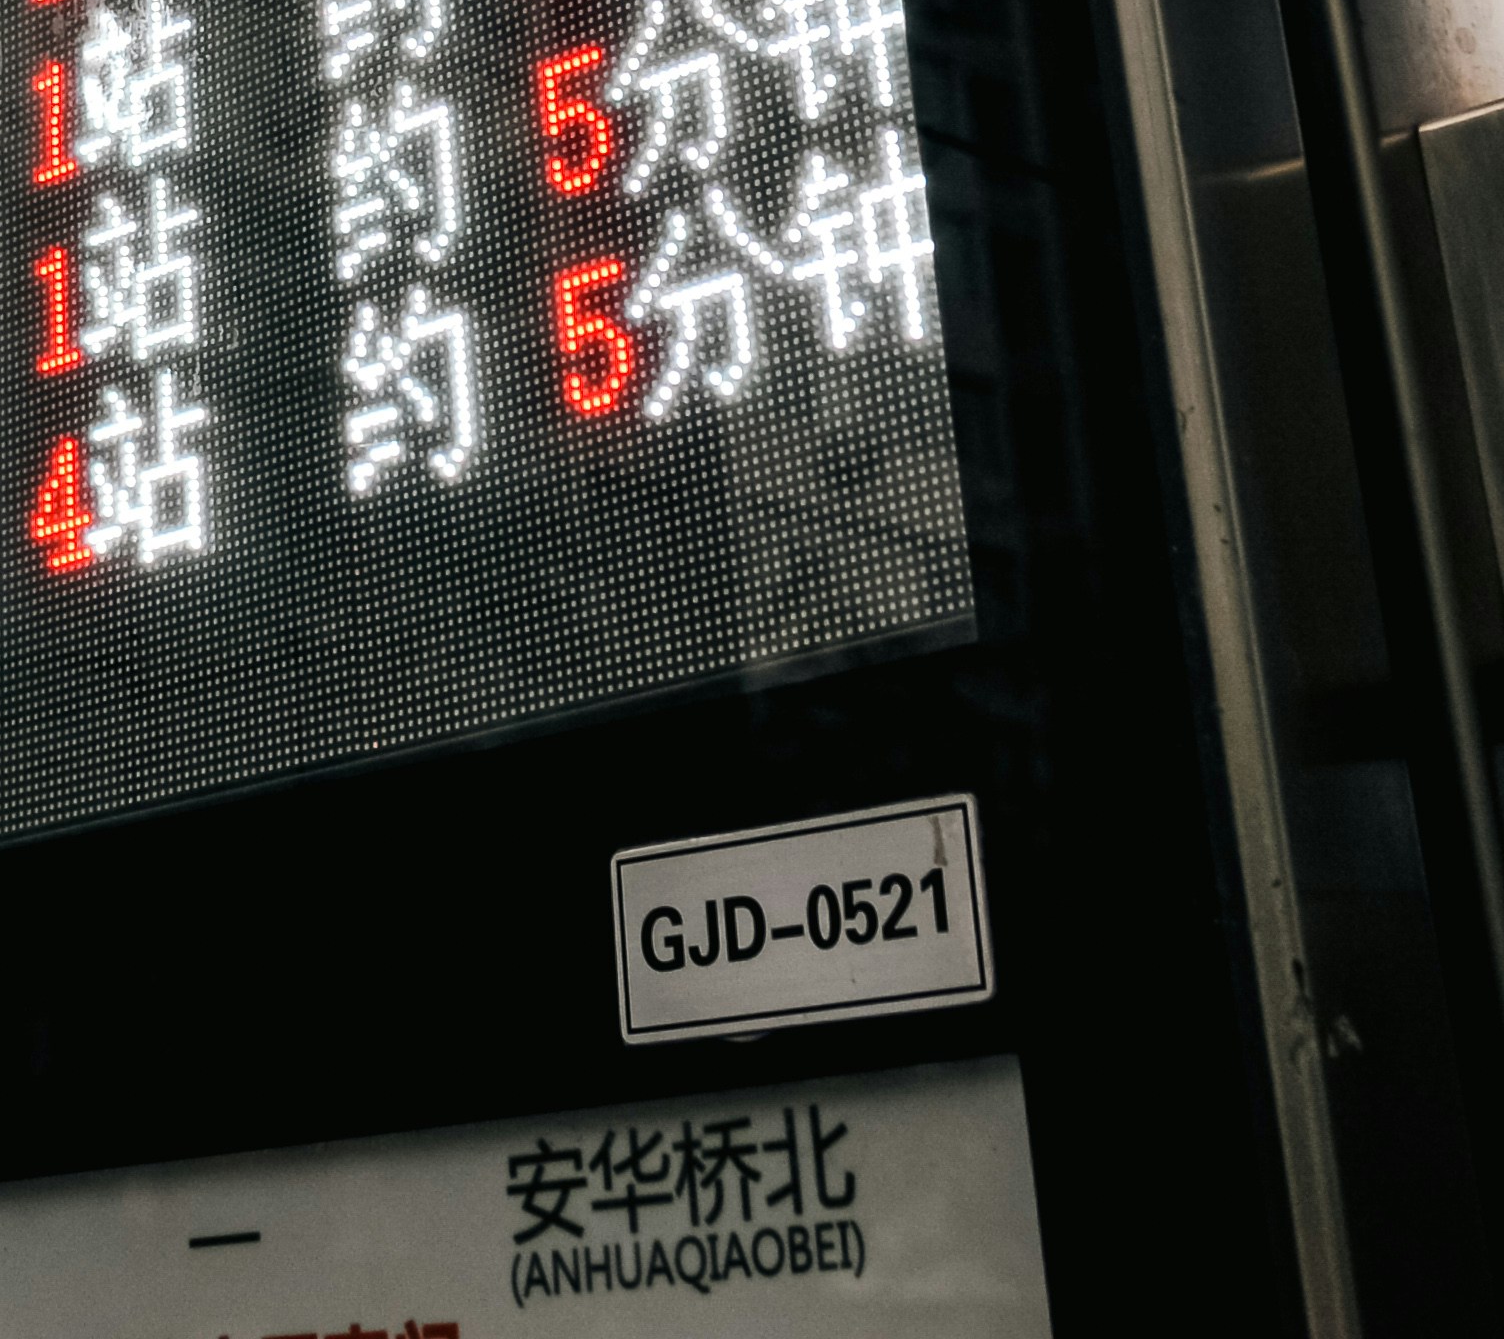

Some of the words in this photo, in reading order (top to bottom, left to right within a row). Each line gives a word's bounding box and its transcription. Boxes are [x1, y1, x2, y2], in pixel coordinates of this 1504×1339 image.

[335, 85, 457, 281] 约
[344, 290, 473, 494] 约
[639, 866, 951, 974] GJD-0521
[505, 1103, 857, 1246] 安华桥北
[510, 1219, 867, 1309] (ANHUAQIAOBEI)
